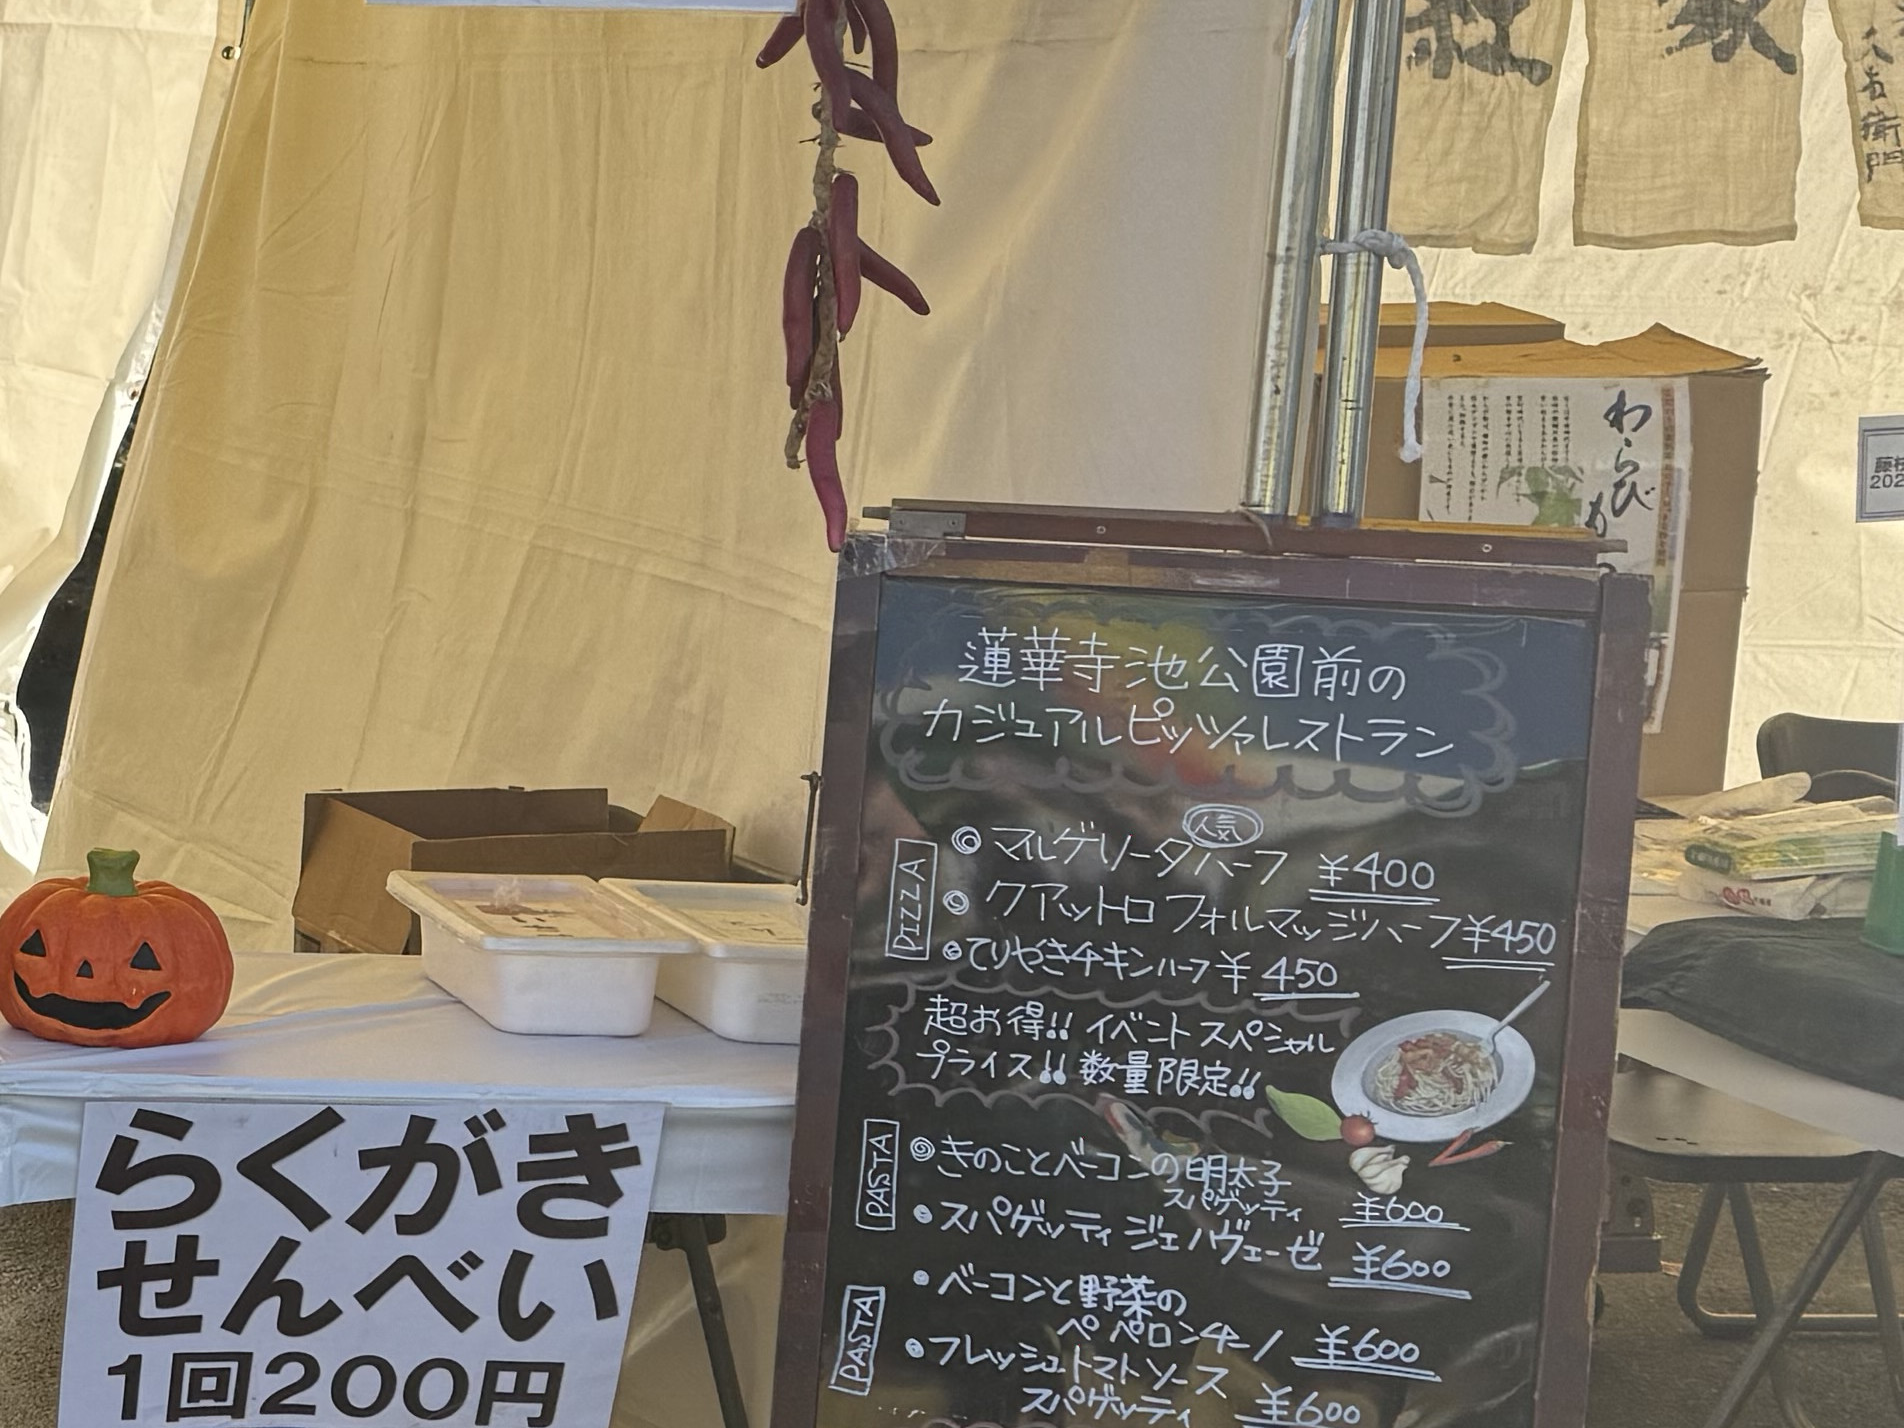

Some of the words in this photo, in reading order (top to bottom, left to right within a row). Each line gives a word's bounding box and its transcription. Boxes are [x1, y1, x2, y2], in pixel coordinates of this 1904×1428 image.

[958, 625, 1407, 702] 蓮華寺池公園前の
[923, 696, 1454, 762] カジュアルピッツァレストラン
[891, 857, 927, 953] PIZZA
[1318, 850, 1436, 893] ¥400
[1465, 913, 1557, 957] ¥450
[95, 1105, 641, 1240] らくがき
[865, 1132, 894, 1218] PASTA
[95, 1234, 620, 1342] せんべい
[937, 1270, 1188, 1320] ベーコンと野菜の
[1351, 1241, 1452, 1281] ¥600
[838, 1295, 881, 1383] PASTA
[1313, 1324, 1420, 1363] ¥600
[105, 1350, 566, 1428] 1回200円
[1254, 1384, 1361, 1427] ¥600
